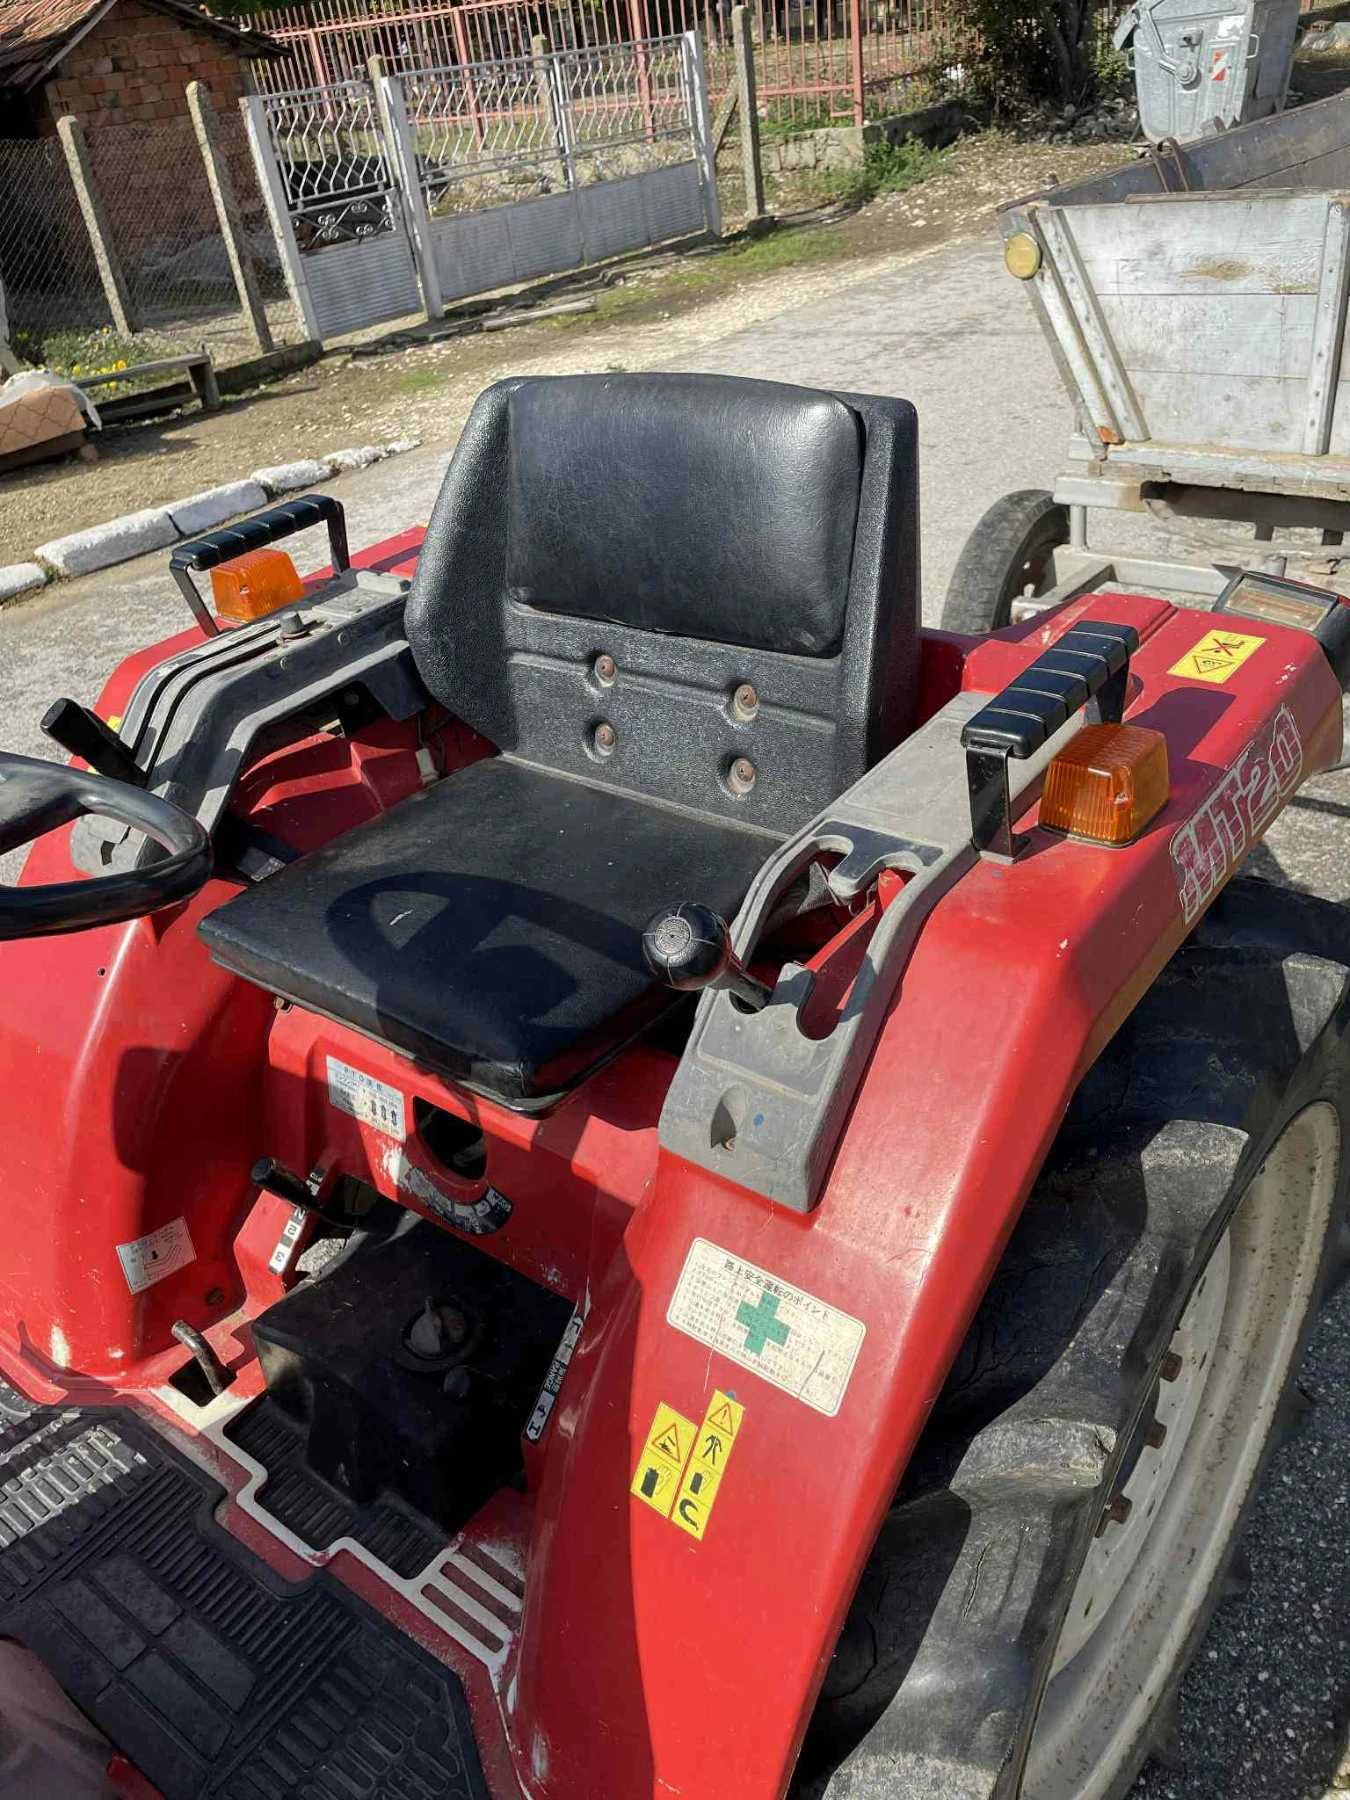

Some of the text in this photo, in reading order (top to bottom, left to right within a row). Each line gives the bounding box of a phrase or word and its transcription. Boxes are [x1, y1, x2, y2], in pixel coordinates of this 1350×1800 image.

[1170, 704, 1303, 925] MT20
[287, 1225, 297, 1236] 2
[275, 1252, 285, 1262] 3
[722, 1258, 831, 1321] 路上安全運転のポイント
[543, 1361, 561, 1391] RANGE
